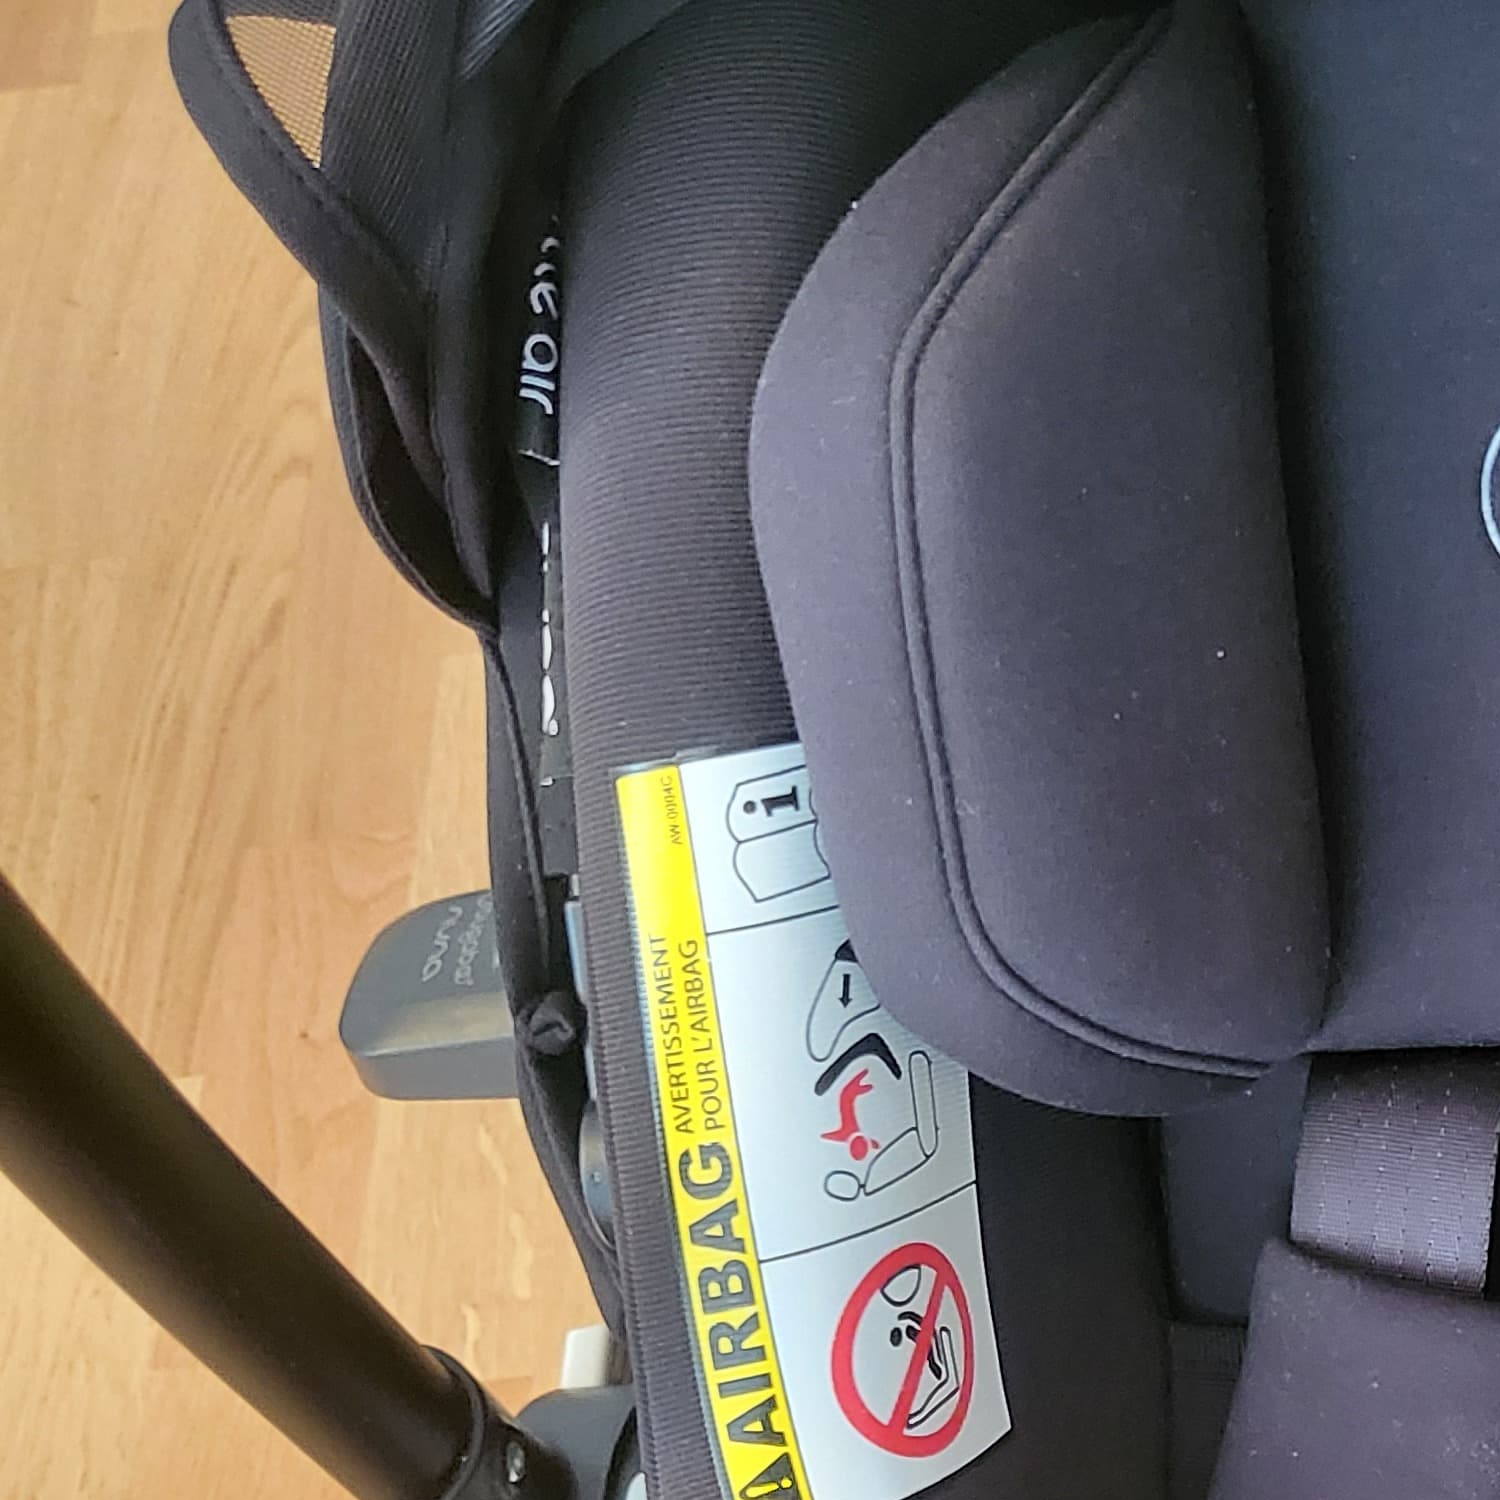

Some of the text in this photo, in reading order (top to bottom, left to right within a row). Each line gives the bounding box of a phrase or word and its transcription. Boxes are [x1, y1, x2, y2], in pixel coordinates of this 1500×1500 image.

[519, 333, 558, 414] air
[421, 905, 463, 983] nuna
[648, 934, 694, 1134] AVERTISSEMENT
[694, 1061, 726, 1132] POUR
[678, 1140, 789, 1447] AIRBAG
